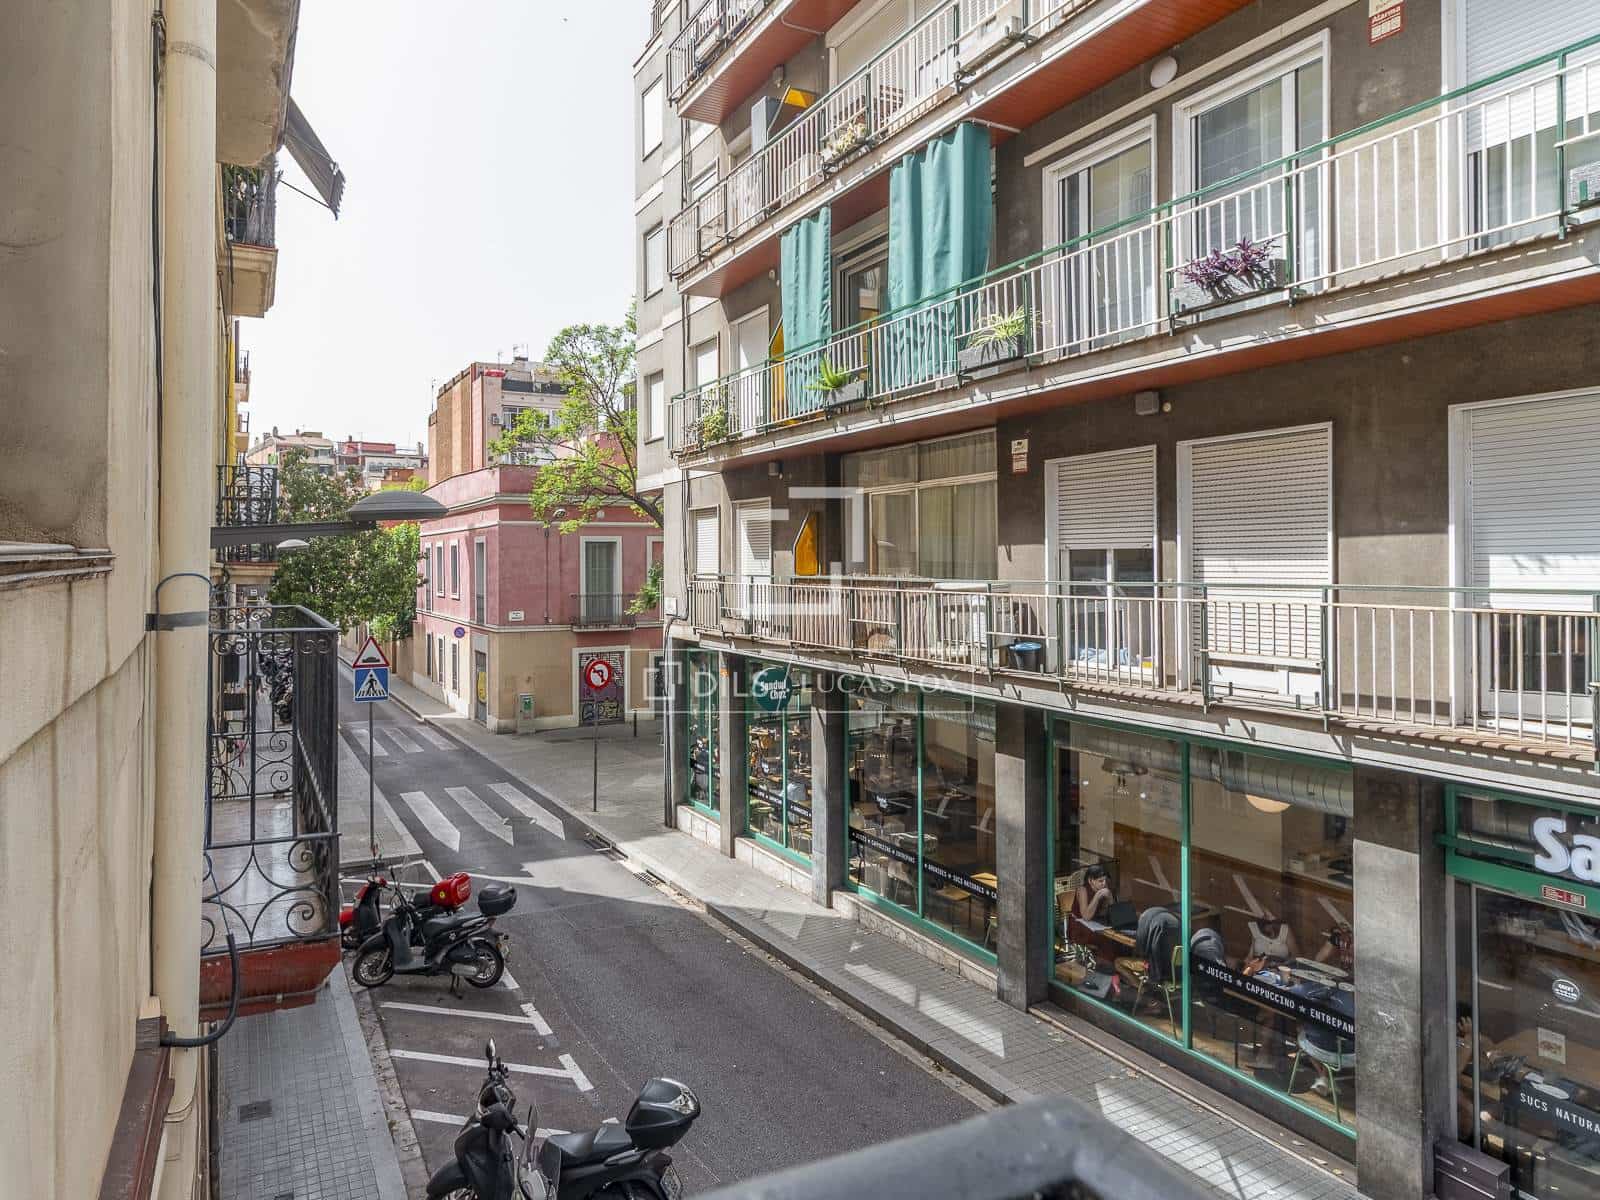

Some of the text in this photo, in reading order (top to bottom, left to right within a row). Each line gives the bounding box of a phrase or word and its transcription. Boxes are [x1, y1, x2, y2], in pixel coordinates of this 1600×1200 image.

[1533, 816, 1600, 884] Sa
[1206, 965, 1233, 984] JUICES
[1246, 981, 1295, 1009] CAPPUCCINO
[1520, 1092, 1548, 1112] SUCS
